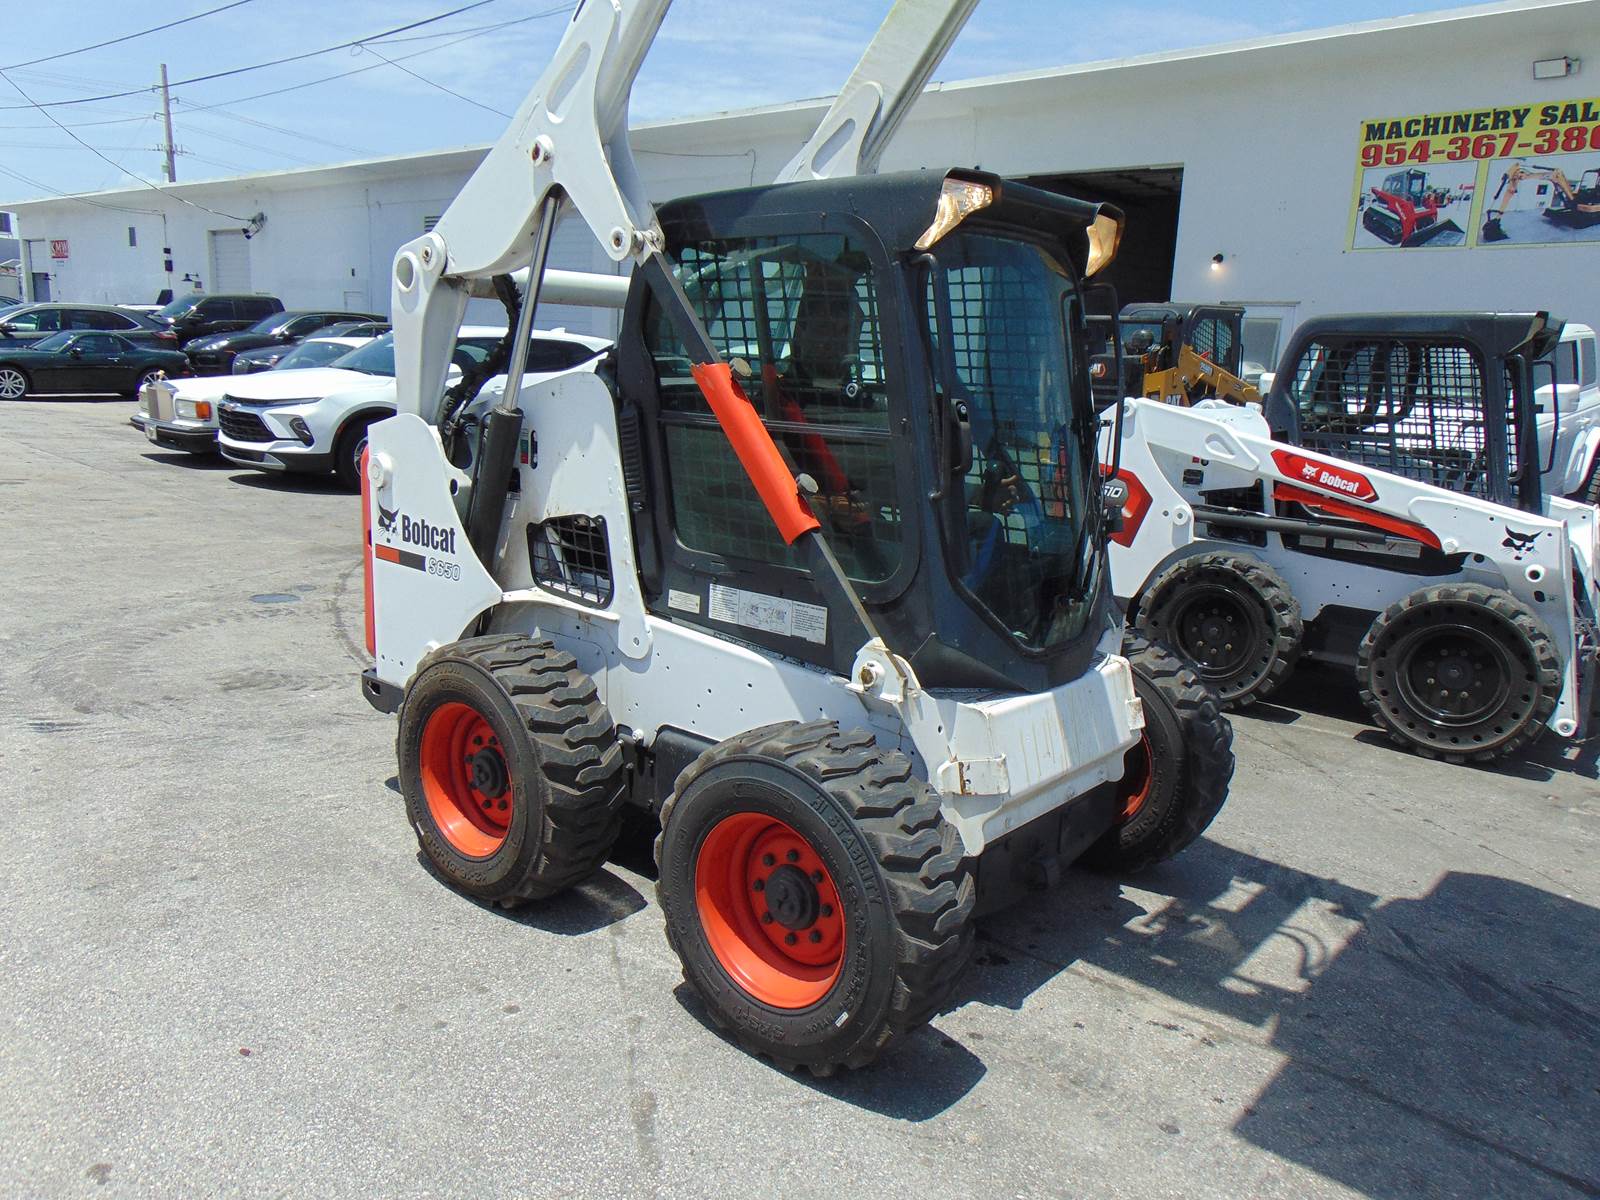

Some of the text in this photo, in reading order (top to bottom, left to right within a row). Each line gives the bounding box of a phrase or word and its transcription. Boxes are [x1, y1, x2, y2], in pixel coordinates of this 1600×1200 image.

[1364, 102, 1599, 142] MACHINERY SAL
[1319, 471, 1360, 494] Bobcat
[401, 514, 456, 555] Bobcat
[428, 557, 461, 582] S650
